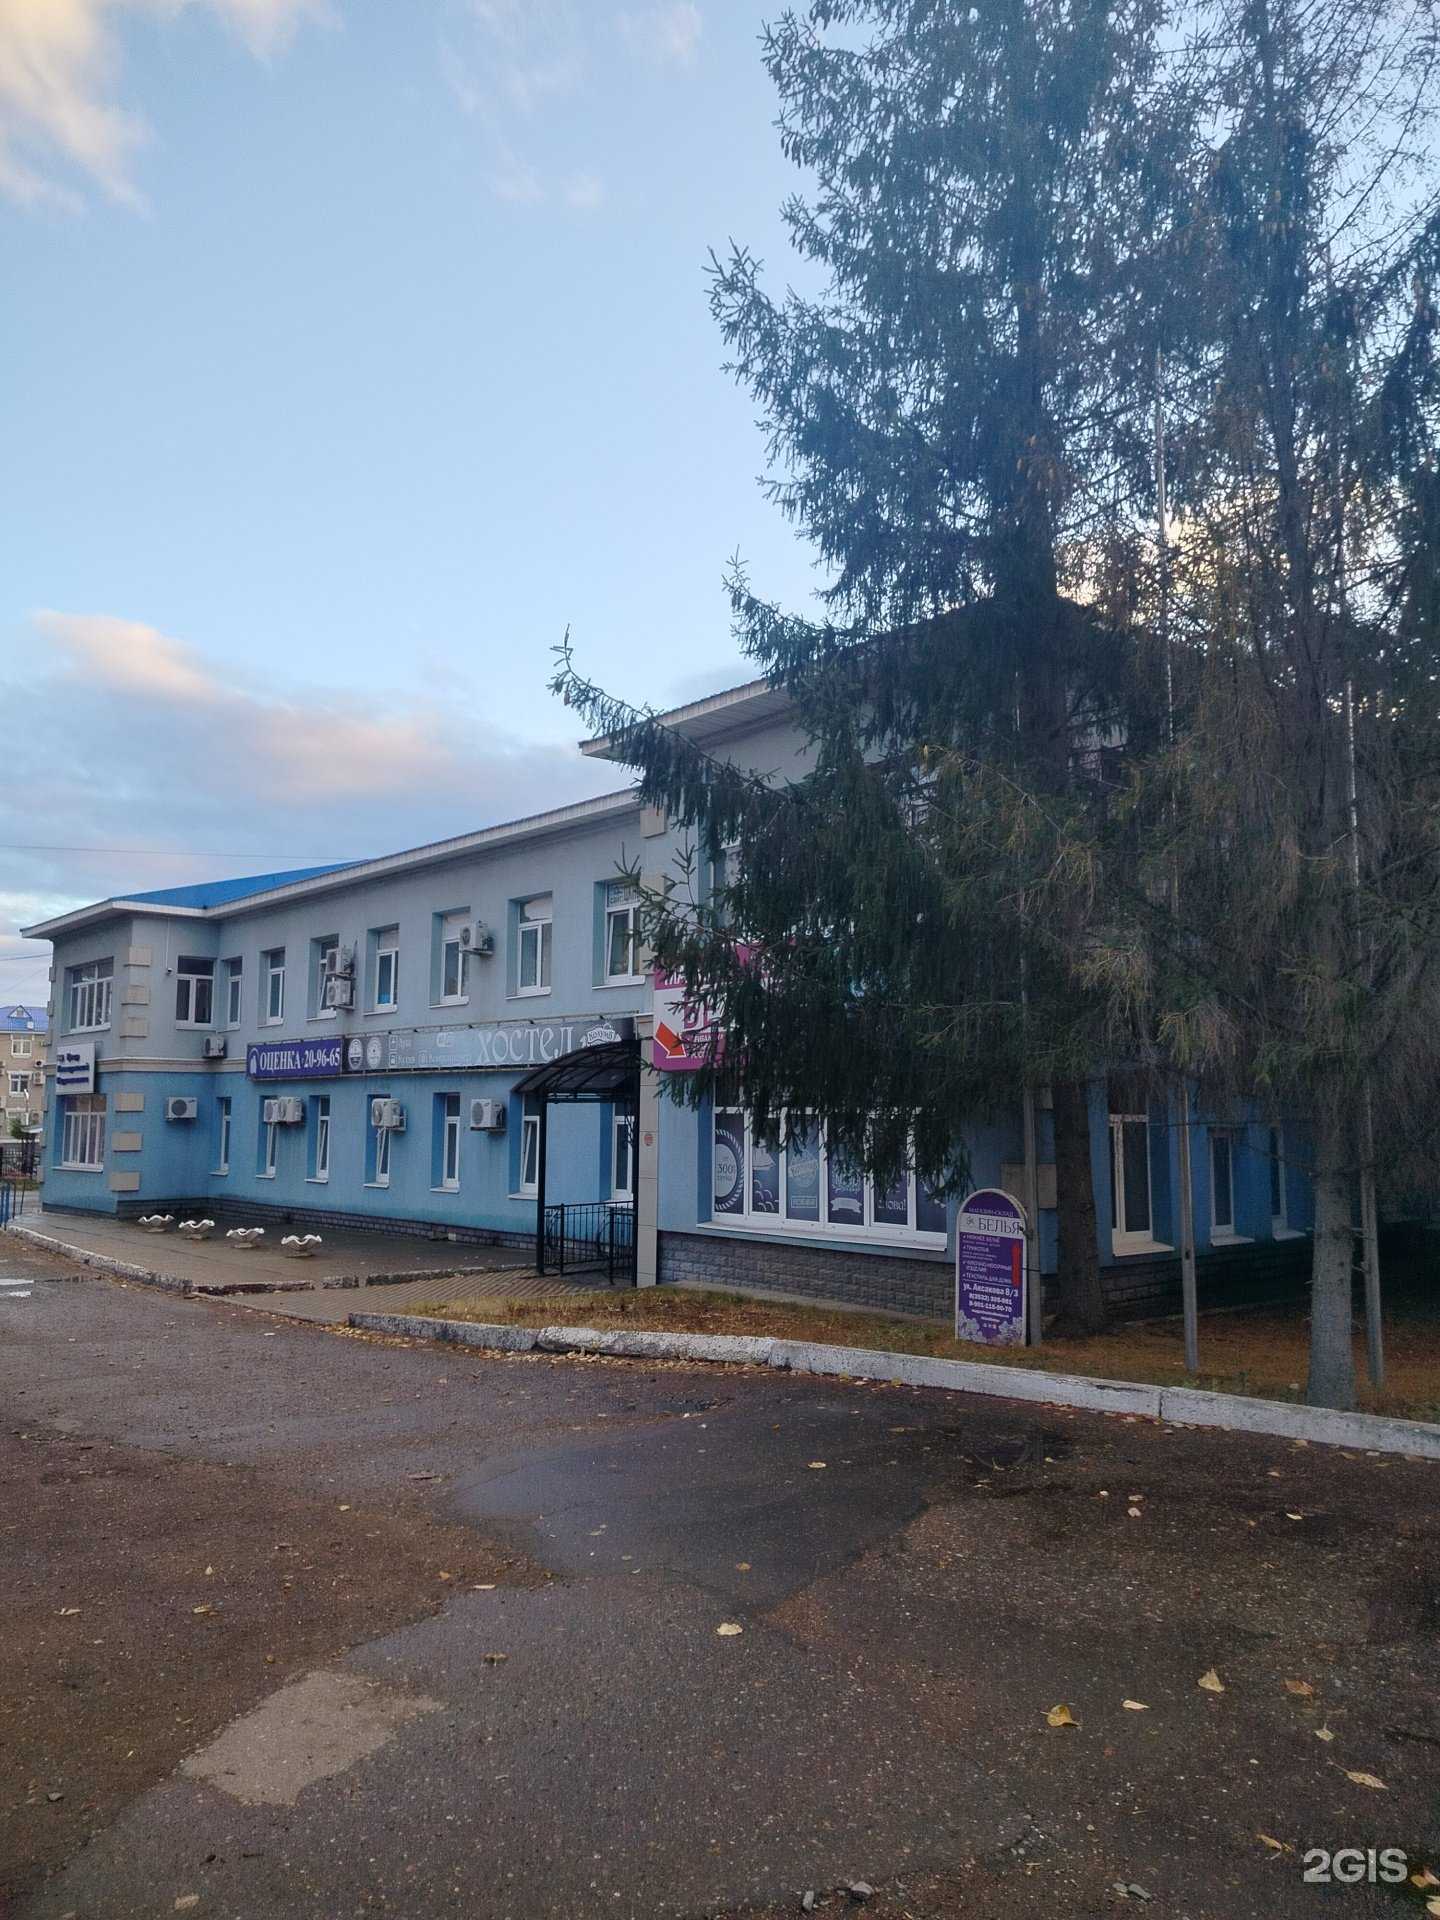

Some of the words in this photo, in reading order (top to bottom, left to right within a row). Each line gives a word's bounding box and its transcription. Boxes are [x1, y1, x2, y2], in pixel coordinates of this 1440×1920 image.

[259, 1051, 301, 1072] ОЦЕНКА
[304, 1047, 341, 1068] 20-96-65
[978, 1217, 1020, 1235] БЕЛЬЯ
